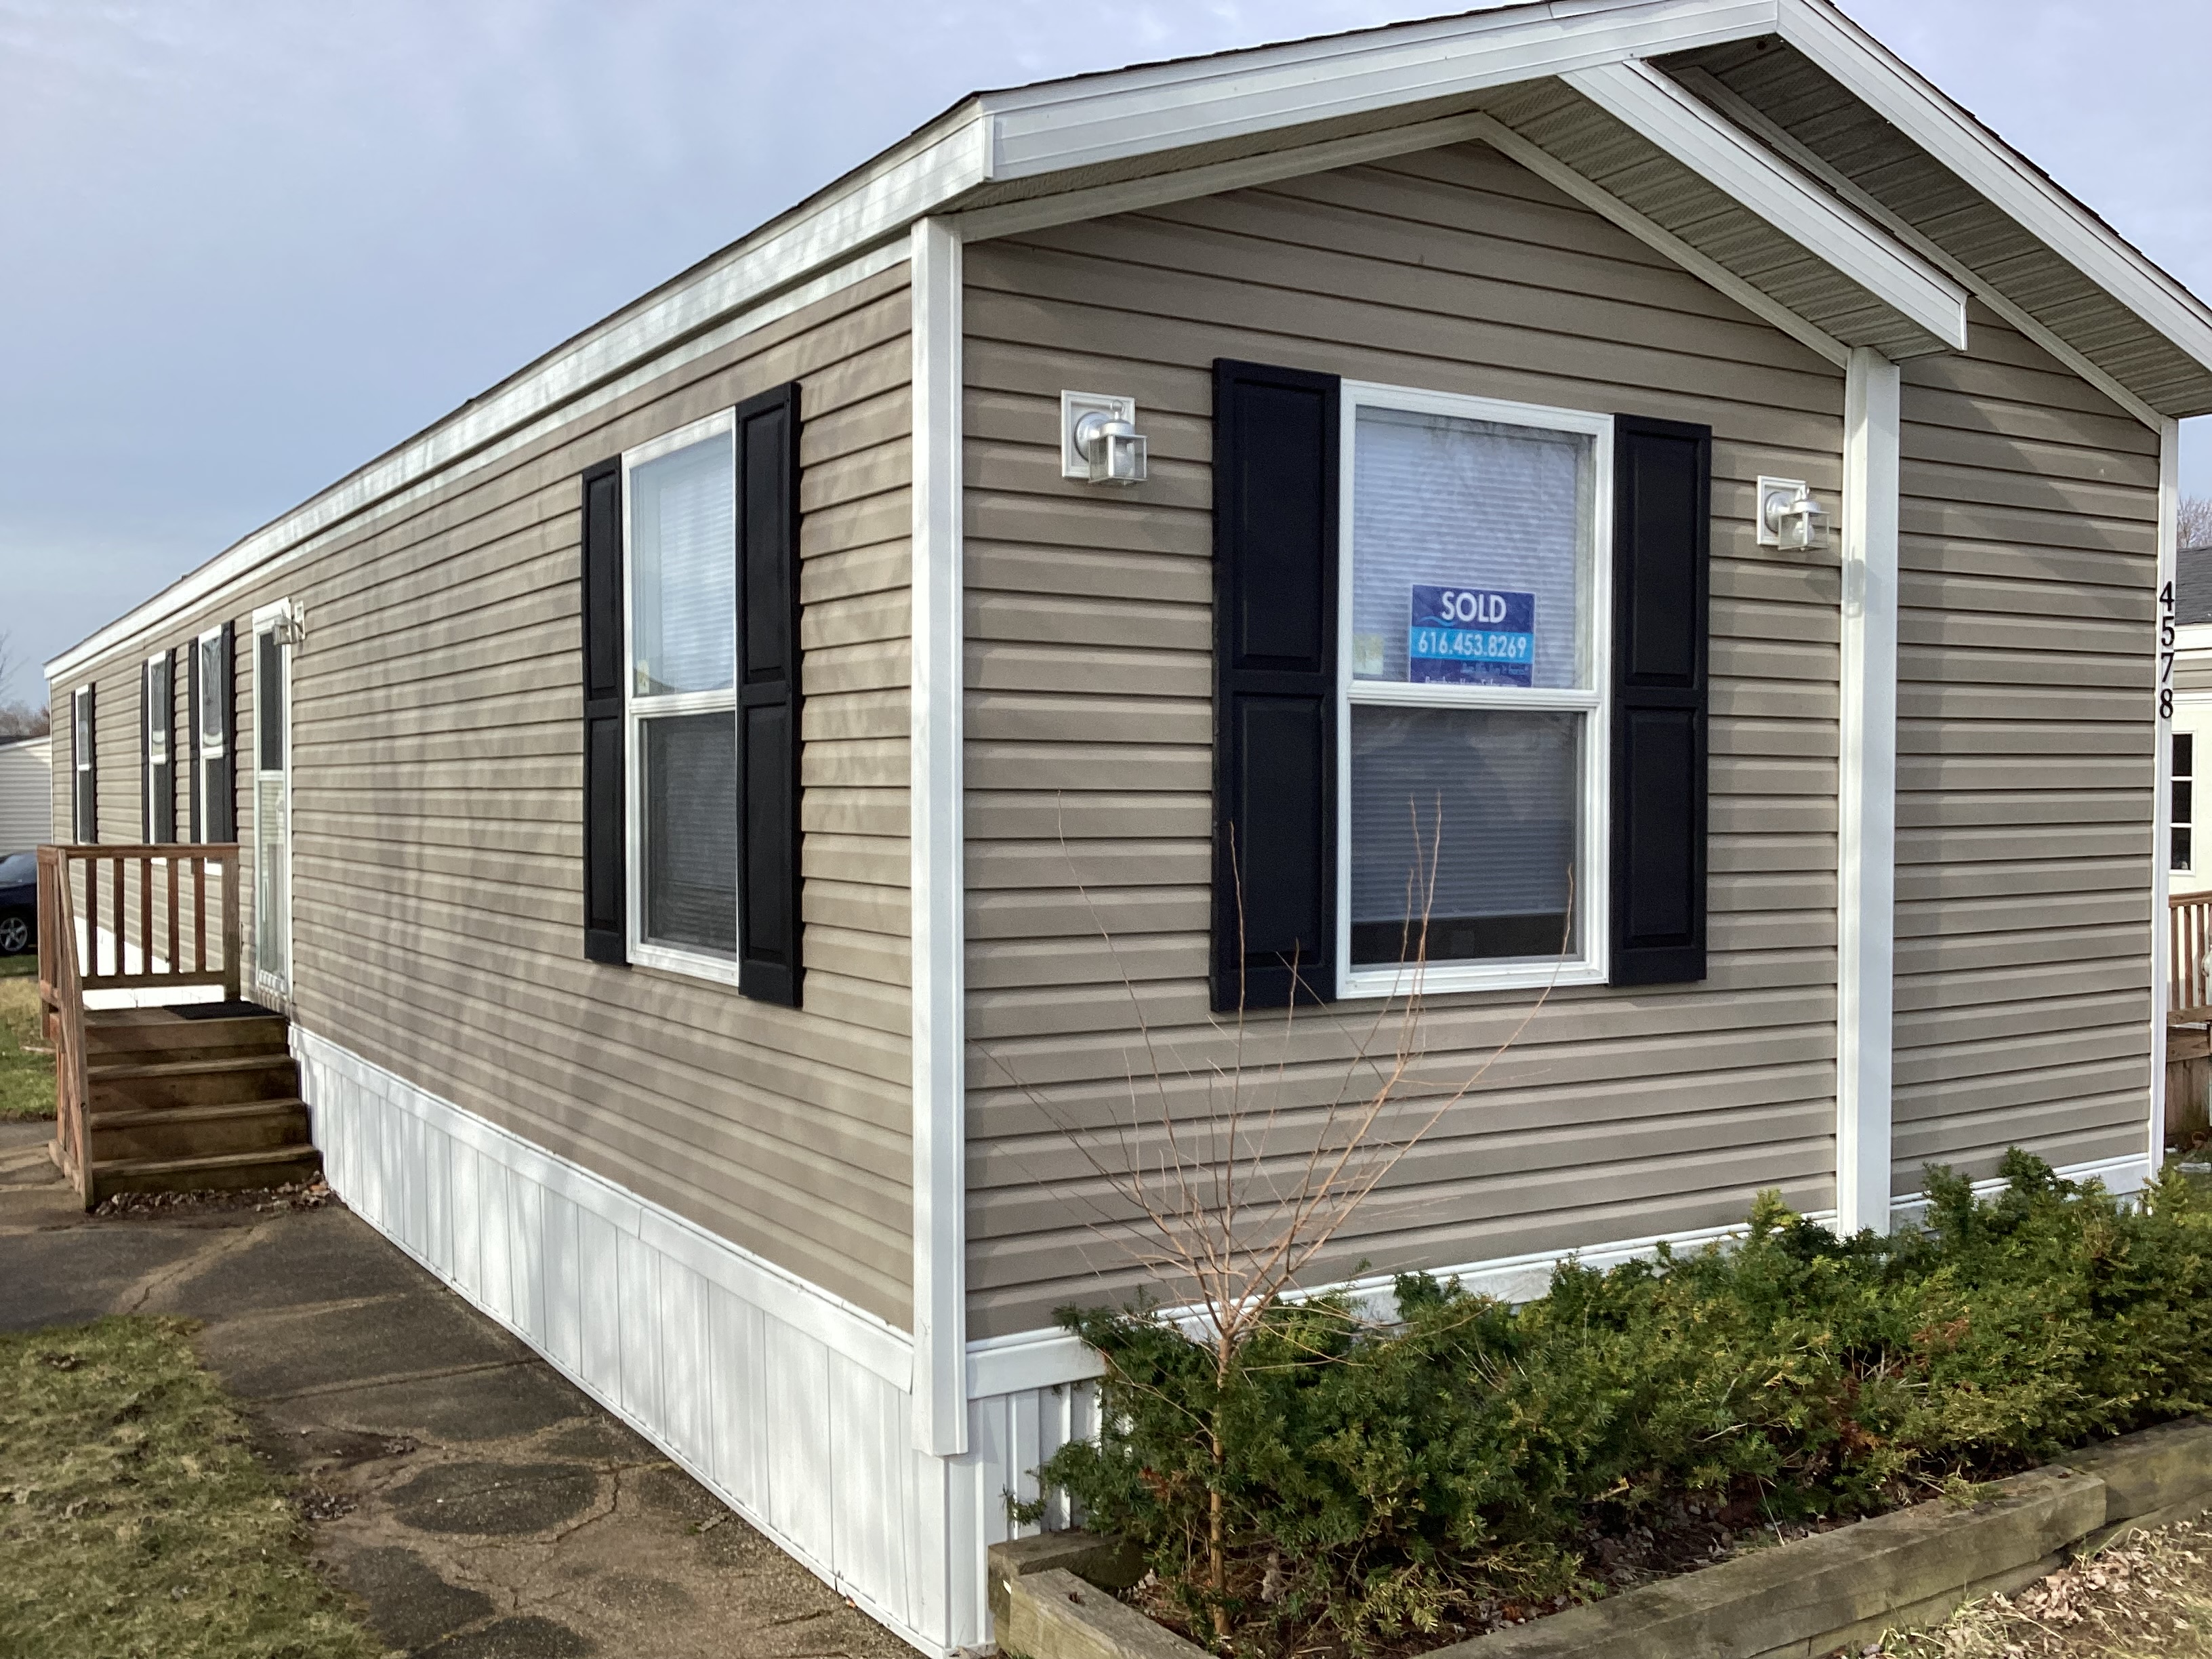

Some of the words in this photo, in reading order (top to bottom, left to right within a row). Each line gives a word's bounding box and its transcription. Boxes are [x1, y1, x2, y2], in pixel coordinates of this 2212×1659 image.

[1441, 591, 1507, 623] SOLD
[1418, 630, 1527, 658] 616.453.8269
[2159, 581, 2175, 719] 4578
